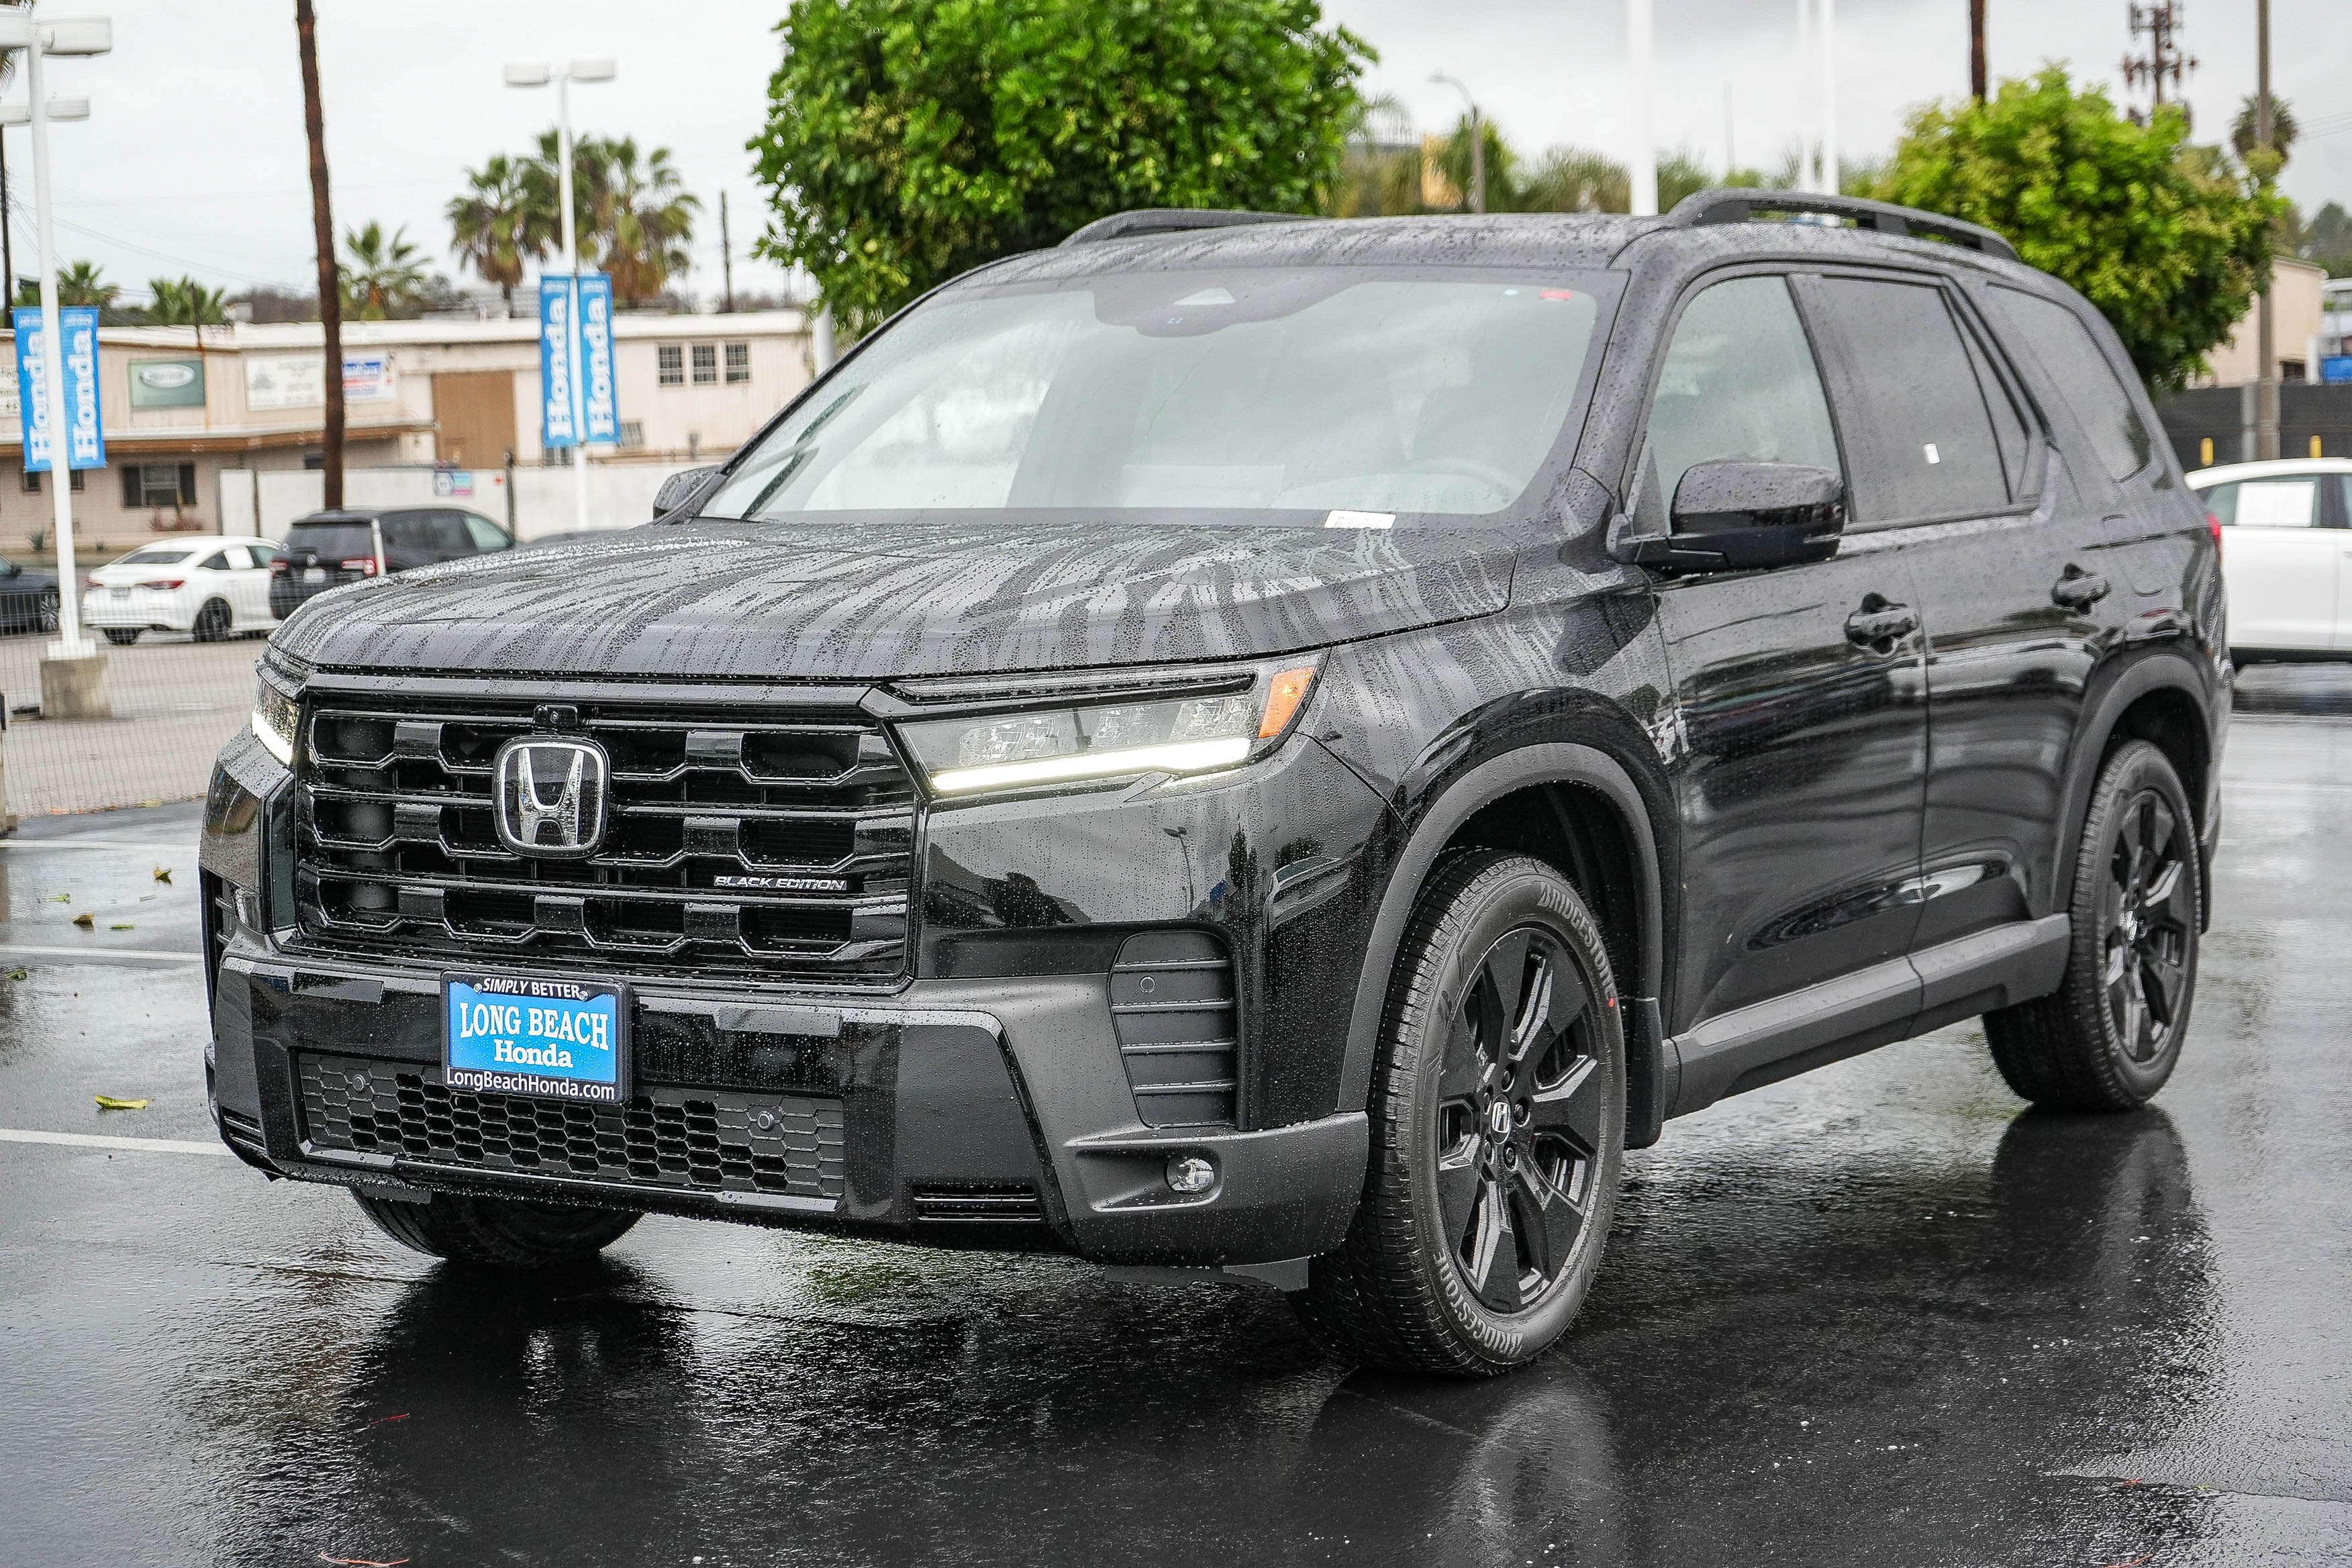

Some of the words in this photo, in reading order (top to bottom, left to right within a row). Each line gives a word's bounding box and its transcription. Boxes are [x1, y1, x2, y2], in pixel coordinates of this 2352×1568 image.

[68, 327, 98, 462] Honda
[544, 295, 573, 440] Honda
[583, 295, 615, 437] Honda
[714, 875, 774, 889] BLACK
[775, 878, 846, 891] EDITION
[1536, 881, 1617, 1000] BRIDGESTONE
[459, 1001, 522, 1038] LONG
[528, 1007, 609, 1051] BEACH
[483, 977, 528, 995] SIMPLY
[531, 981, 580, 999] BETTER
[446, 1065, 616, 1100] LongBeachHonda.com
[493, 1038, 574, 1069] Honda
[1433, 1247, 1523, 1359] BRIDGESTONE
